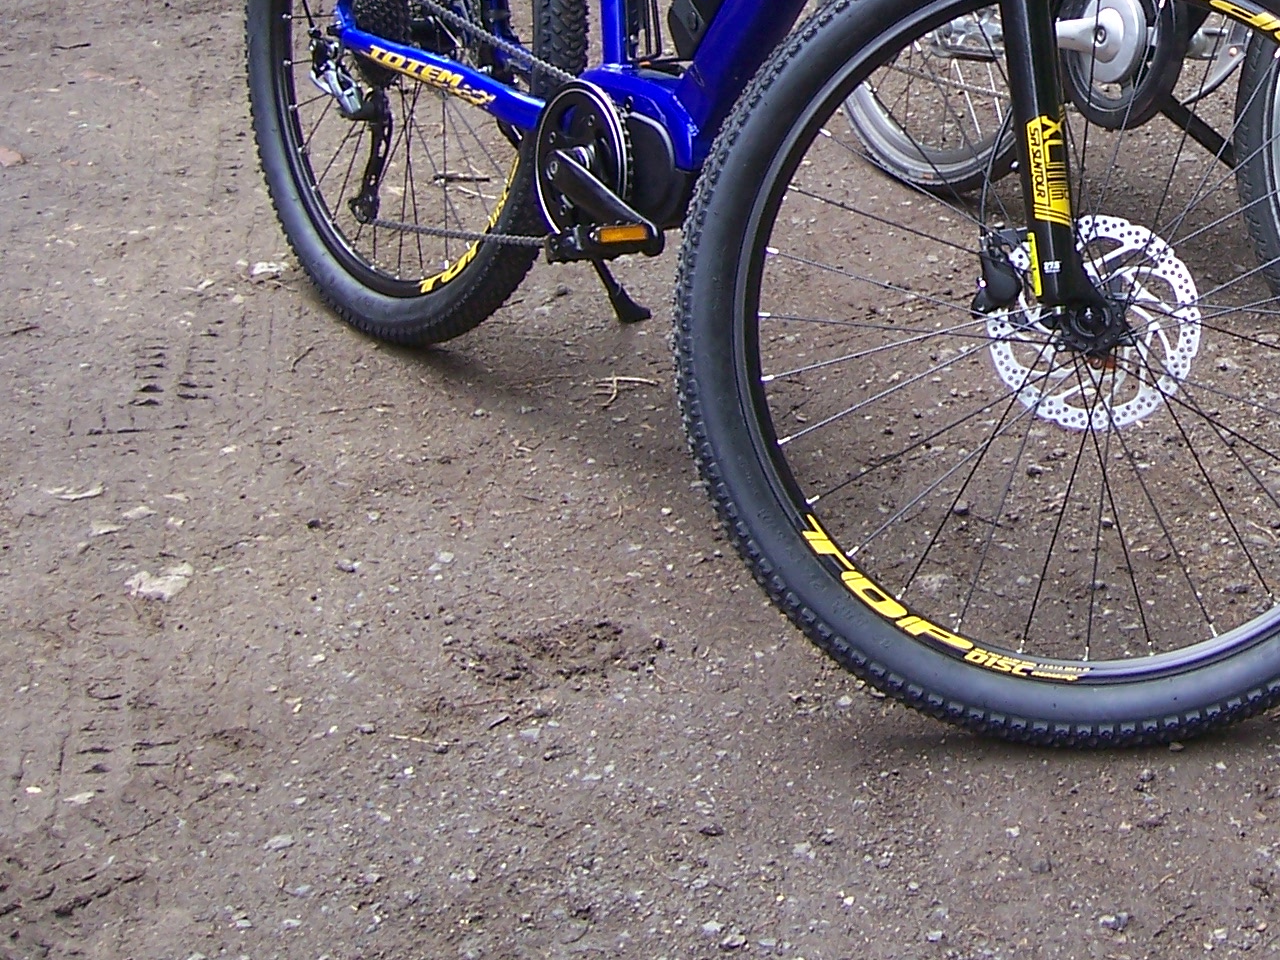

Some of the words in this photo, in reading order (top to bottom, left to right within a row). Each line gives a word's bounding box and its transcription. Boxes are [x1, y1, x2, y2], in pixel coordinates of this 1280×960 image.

[368, 44, 465, 88] TOTEM
[1031, 148, 1047, 199] SUNTOUR
[801, 513, 975, 650] TOP
[963, 649, 1035, 677] DISC
